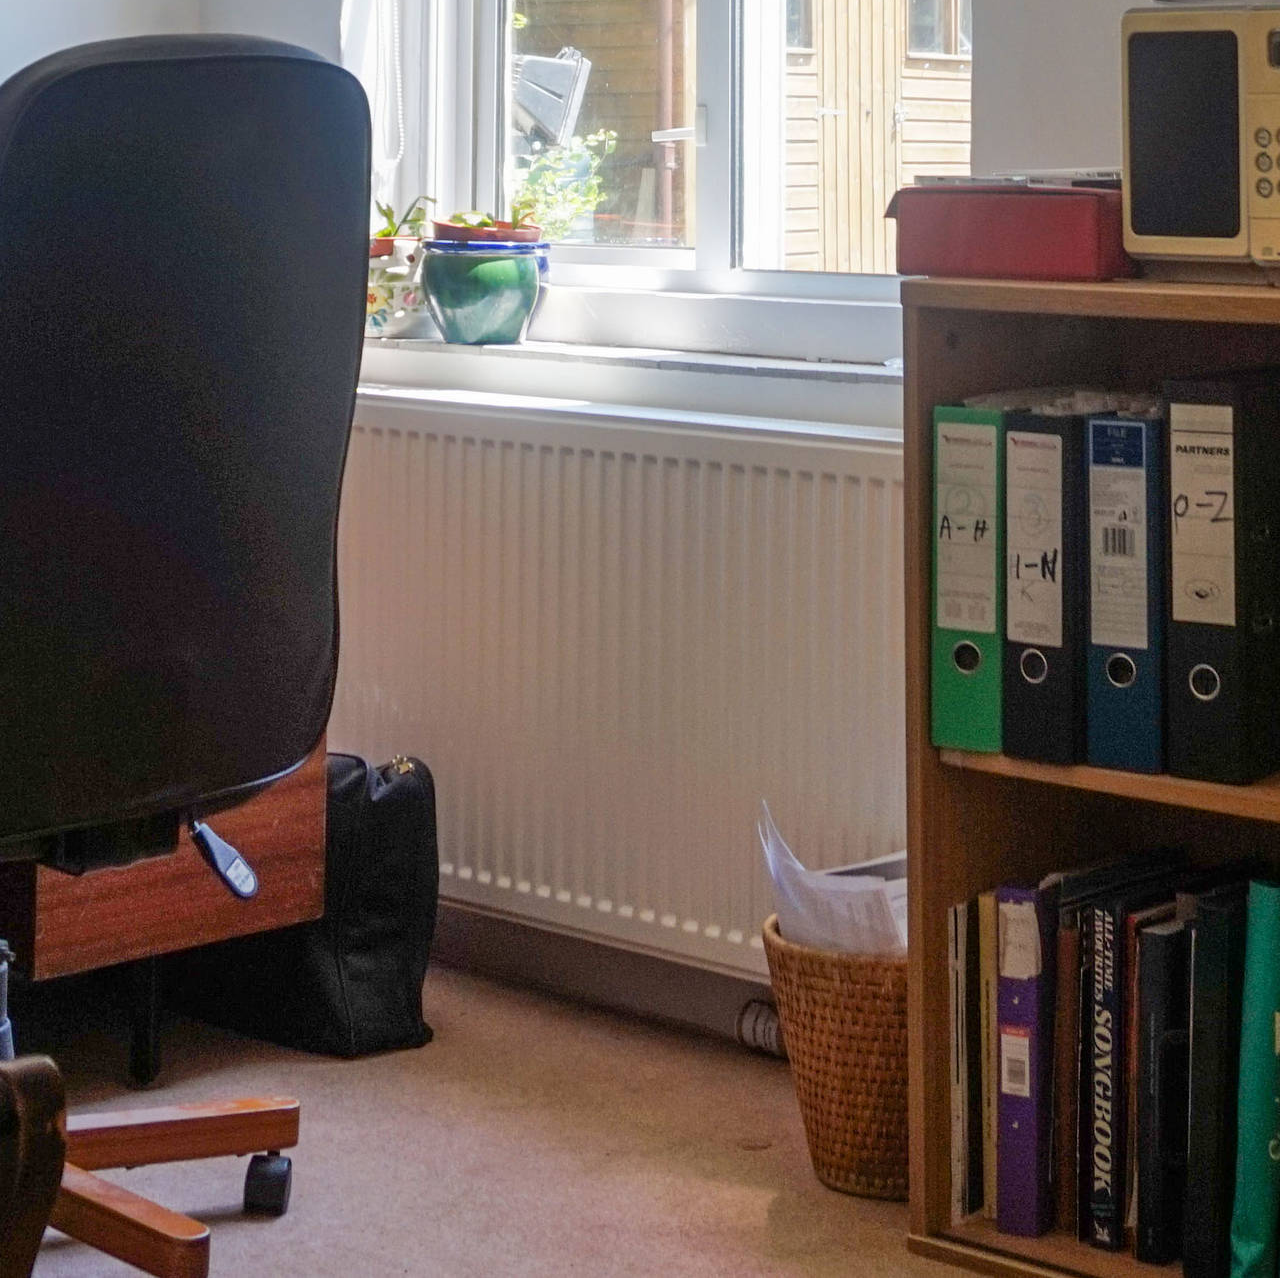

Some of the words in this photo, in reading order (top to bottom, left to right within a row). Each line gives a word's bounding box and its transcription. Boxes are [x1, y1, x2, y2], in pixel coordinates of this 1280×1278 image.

[1175, 444, 1231, 456] PARTNERS
[1094, 908, 1104, 1003] FAVOURITES
[1104, 909, 1114, 992] ALL-TIME
[1093, 1002, 1114, 1197] SONGBOOK
